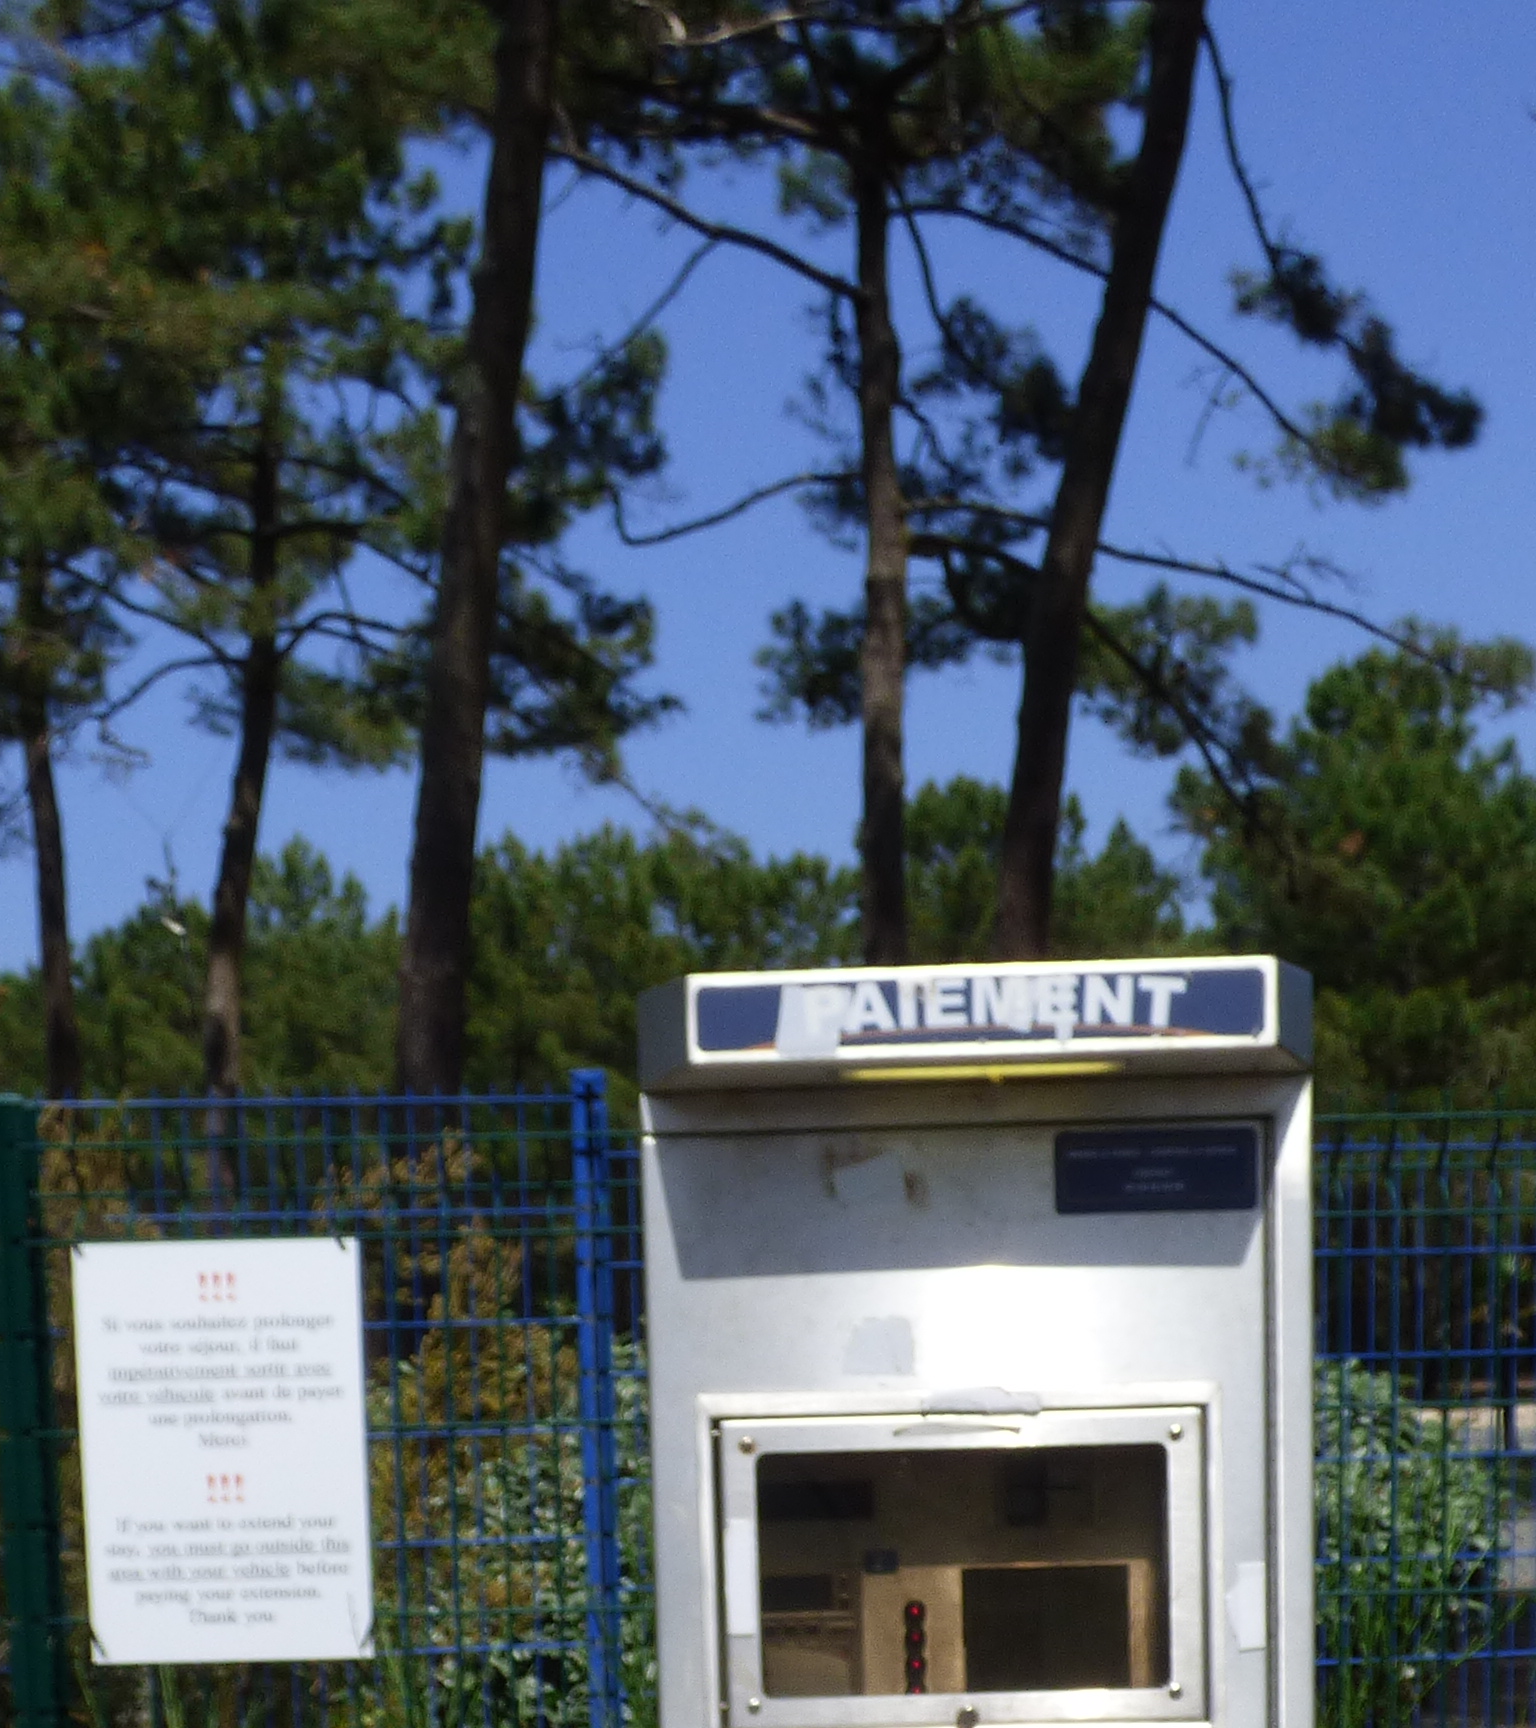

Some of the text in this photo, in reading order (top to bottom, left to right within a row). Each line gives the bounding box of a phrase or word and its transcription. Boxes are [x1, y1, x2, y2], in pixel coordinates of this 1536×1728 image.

[804, 974, 1188, 1034] PAIEMENT
[125, 1319, 163, 1331] vous
[170, 1316, 247, 1330] souhaitez
[253, 1314, 334, 1332] prolonger
[139, 1340, 182, 1353] votre
[98, 1389, 140, 1402] votre
[222, 1386, 265, 1399] avant
[271, 1384, 290, 1398] de
[297, 1385, 343, 1402] payer
[148, 1413, 178, 1426] une
[135, 1520, 164, 1534] you
[173, 1518, 210, 1531] want
[216, 1518, 231, 1530] to
[238, 1514, 292, 1530] extend
[298, 1515, 336, 1531] your
[146, 1543, 178, 1558] you
[186, 1541, 223, 1555] must
[231, 1542, 250, 1557] go
[258, 1538, 314, 1554] outside
[320, 1537, 350, 1553] this
[147, 1564, 183, 1580] with
[186, 1566, 223, 1582] your
[231, 1562, 290, 1578] vehicle
[296, 1561, 349, 1576] before
[135, 1589, 190, 1605] paying
[196, 1587, 234, 1602] your
[189, 1608, 237, 1623] Thank
